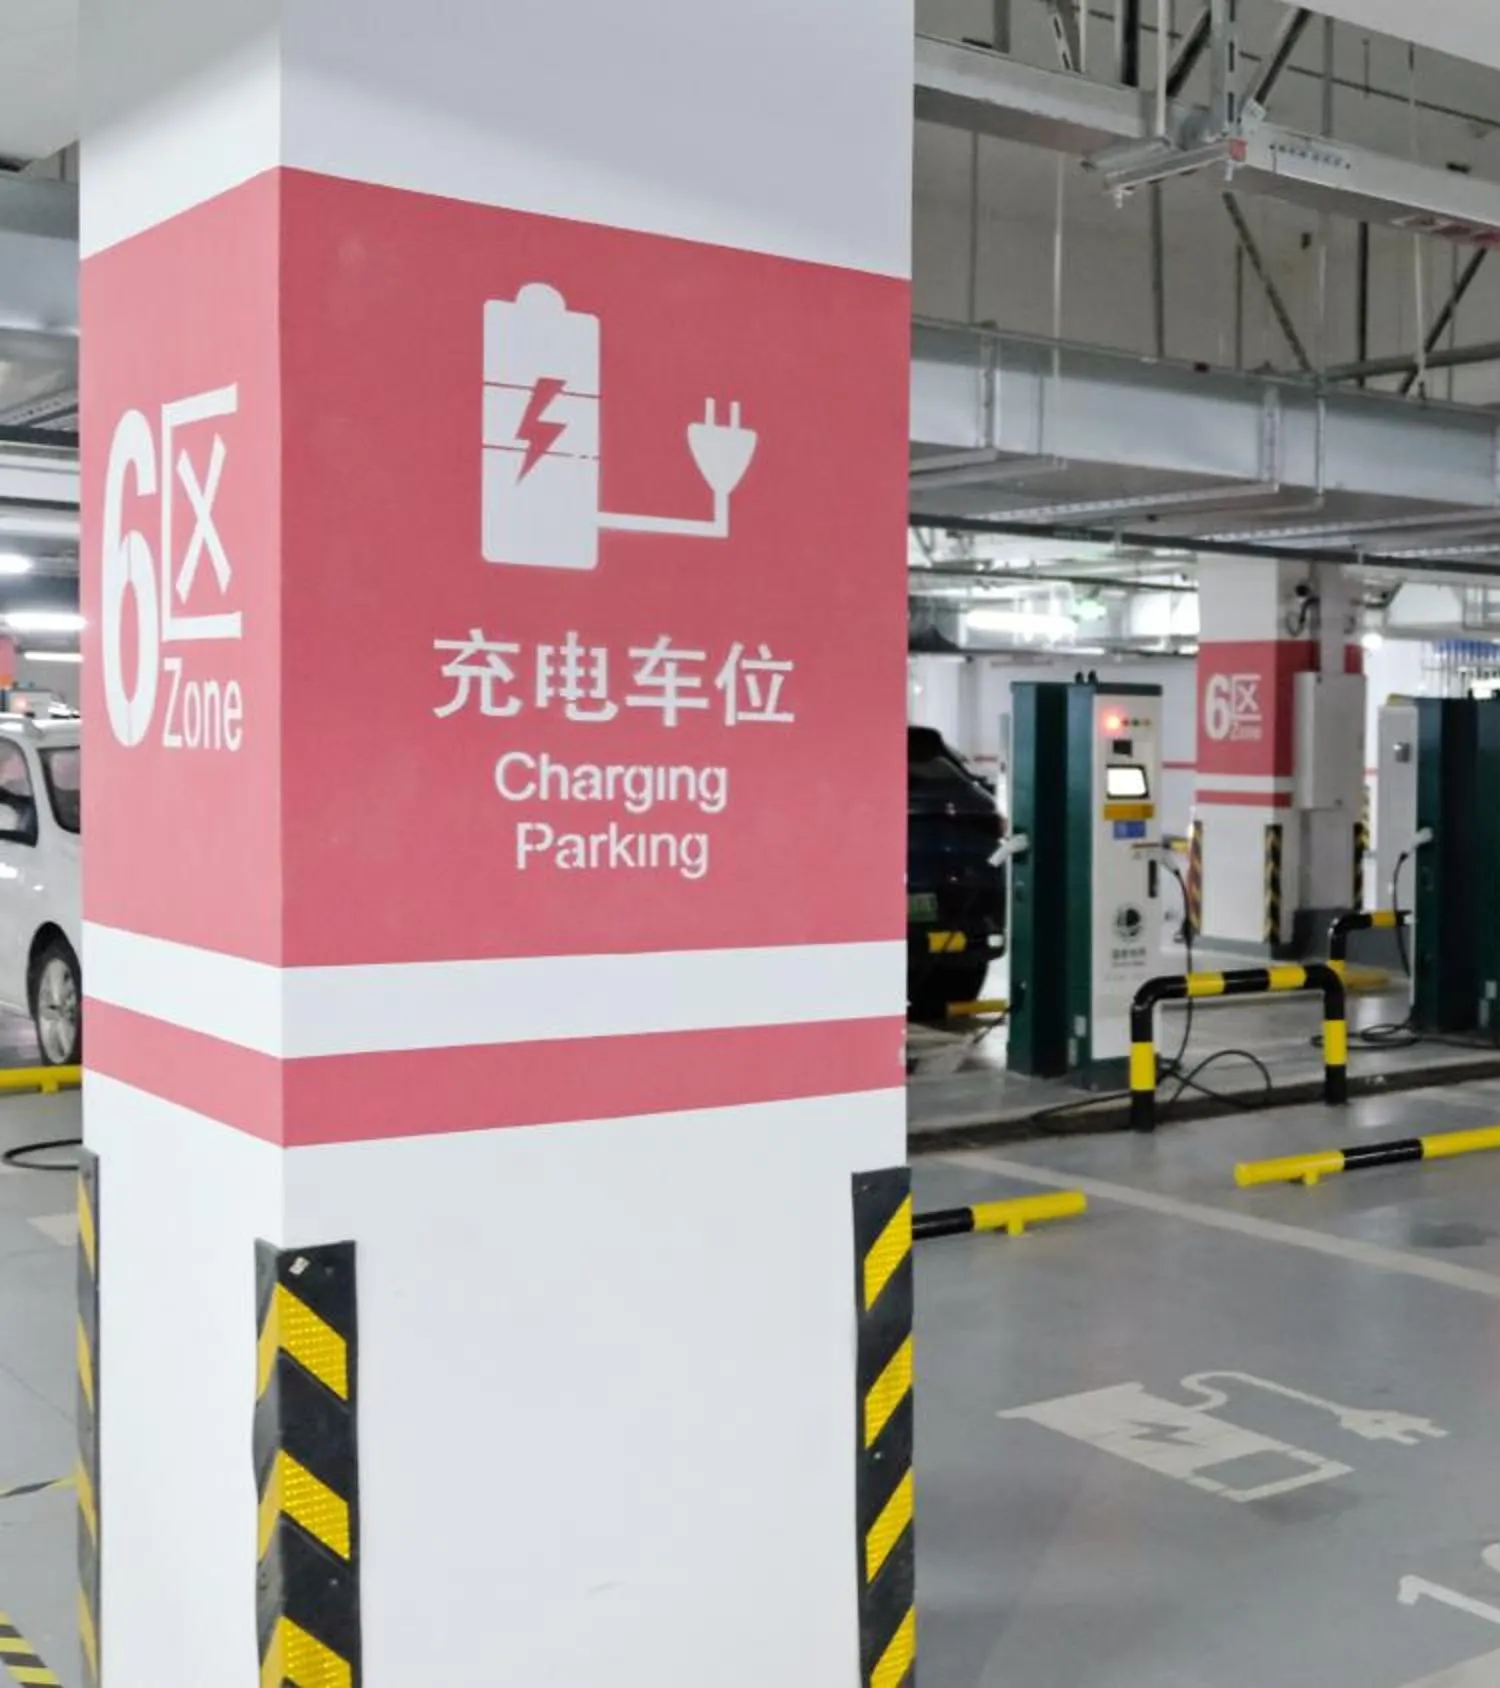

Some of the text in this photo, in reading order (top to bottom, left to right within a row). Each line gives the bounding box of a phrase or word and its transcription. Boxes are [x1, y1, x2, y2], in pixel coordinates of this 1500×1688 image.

[102, 382, 242, 748] 6区
[162, 656, 243, 753] Zone
[432, 627, 796, 728] 充电车位
[1205, 672, 1263, 742] 6区
[494, 750, 729, 814] Charging
[515, 820, 710, 880] Parking
